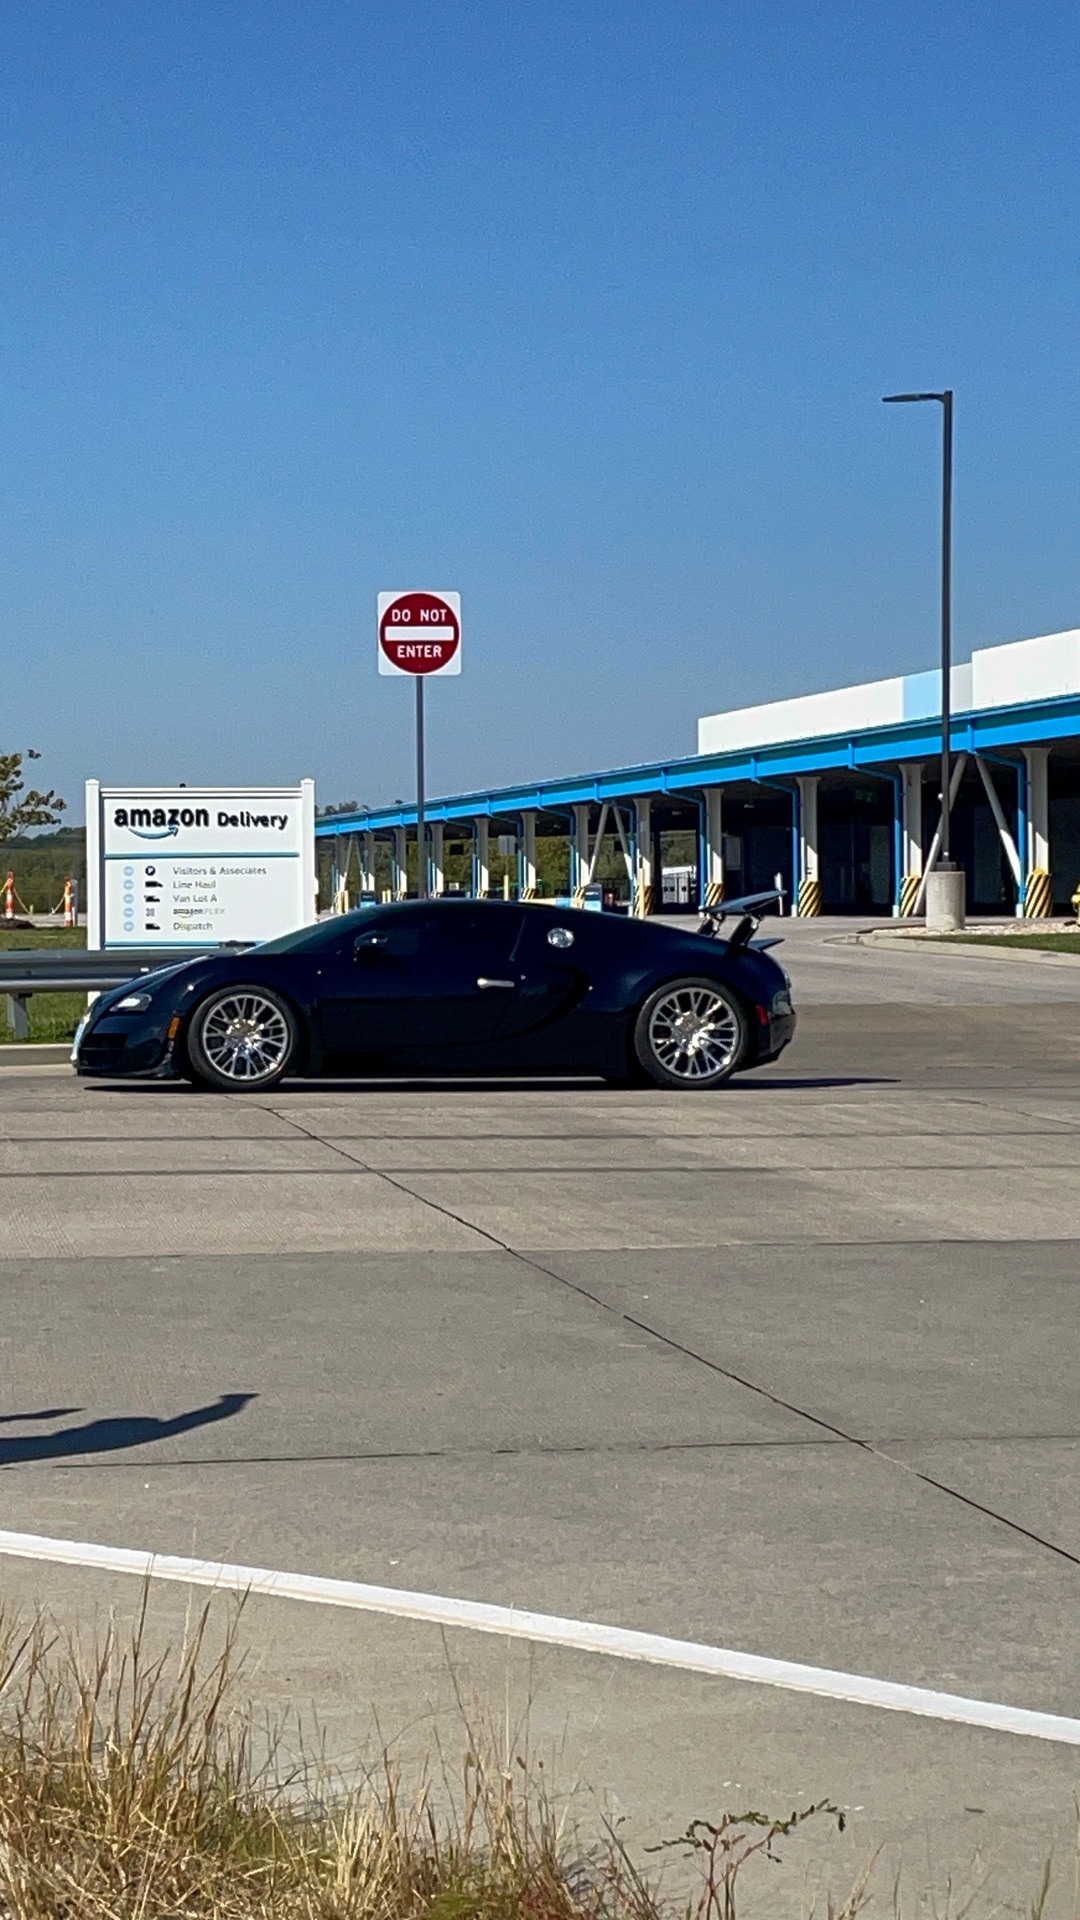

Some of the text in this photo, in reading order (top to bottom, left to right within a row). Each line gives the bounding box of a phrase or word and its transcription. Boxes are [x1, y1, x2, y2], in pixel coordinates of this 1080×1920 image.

[391, 608, 447, 622] DO NOT
[397, 645, 442, 658] ENTER
[114, 808, 288, 830] amazon Delivery
[173, 867, 267, 875] Visitors & Associates
[173, 895, 218, 903] Van Lot A
[173, 922, 213, 931] Dispatch
